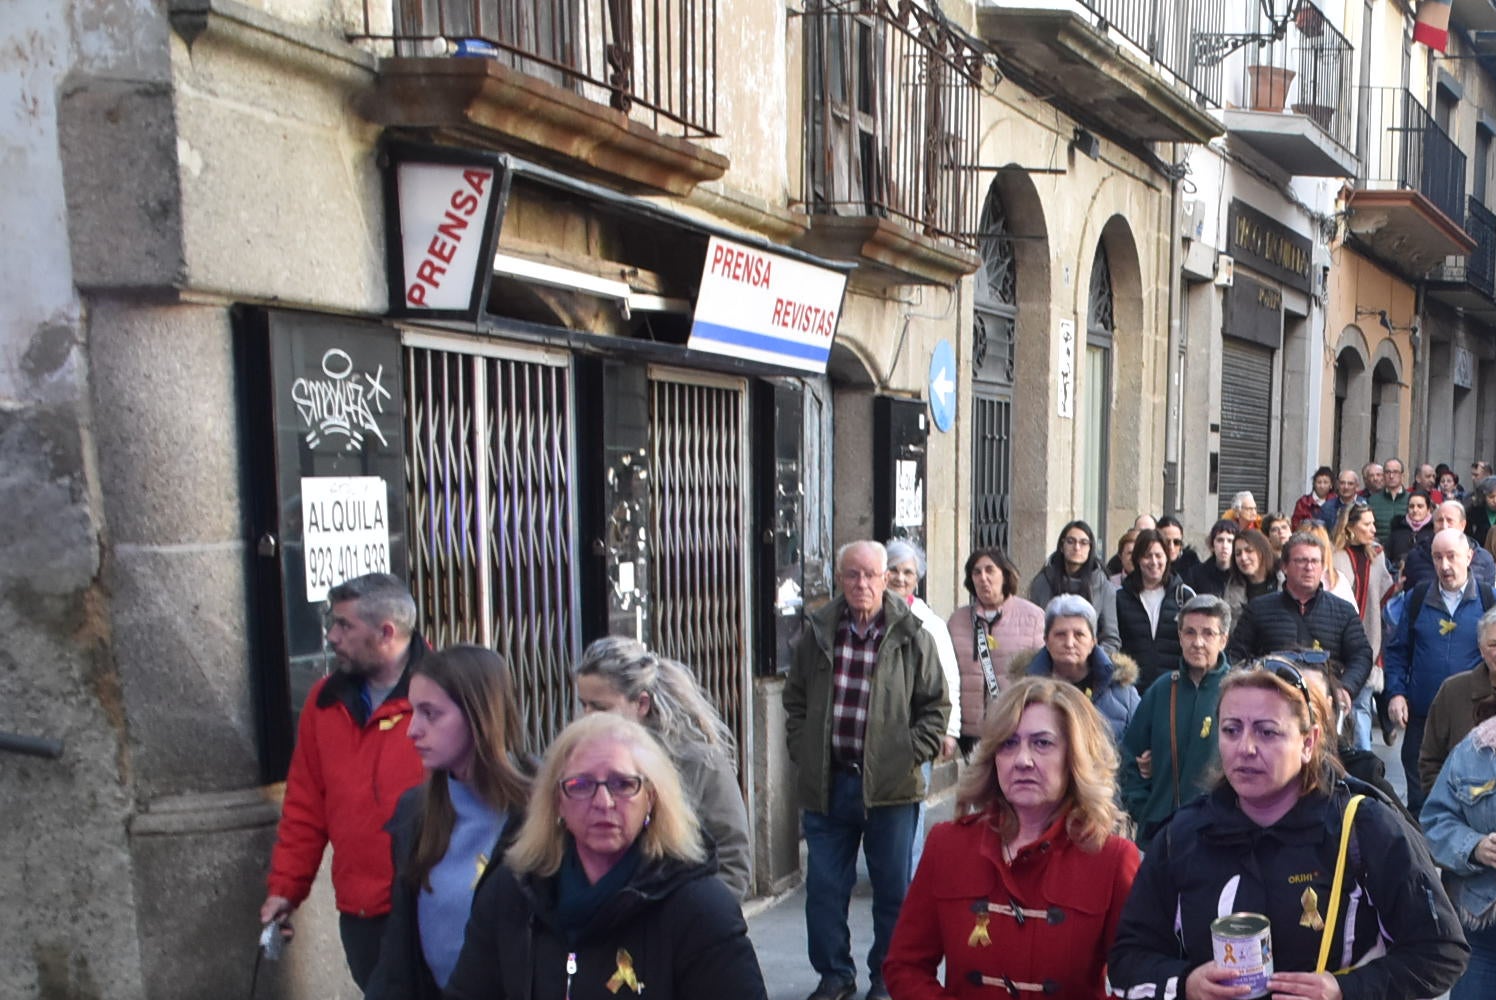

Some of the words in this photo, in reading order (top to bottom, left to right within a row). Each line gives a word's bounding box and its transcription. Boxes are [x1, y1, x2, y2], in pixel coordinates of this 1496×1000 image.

[406, 169, 492, 308] PRENSA
[711, 243, 772, 290] PRENSA
[772, 297, 835, 337] REVISTAS
[308, 499, 384, 533] ALQUILA
[309, 546, 334, 589] 923
